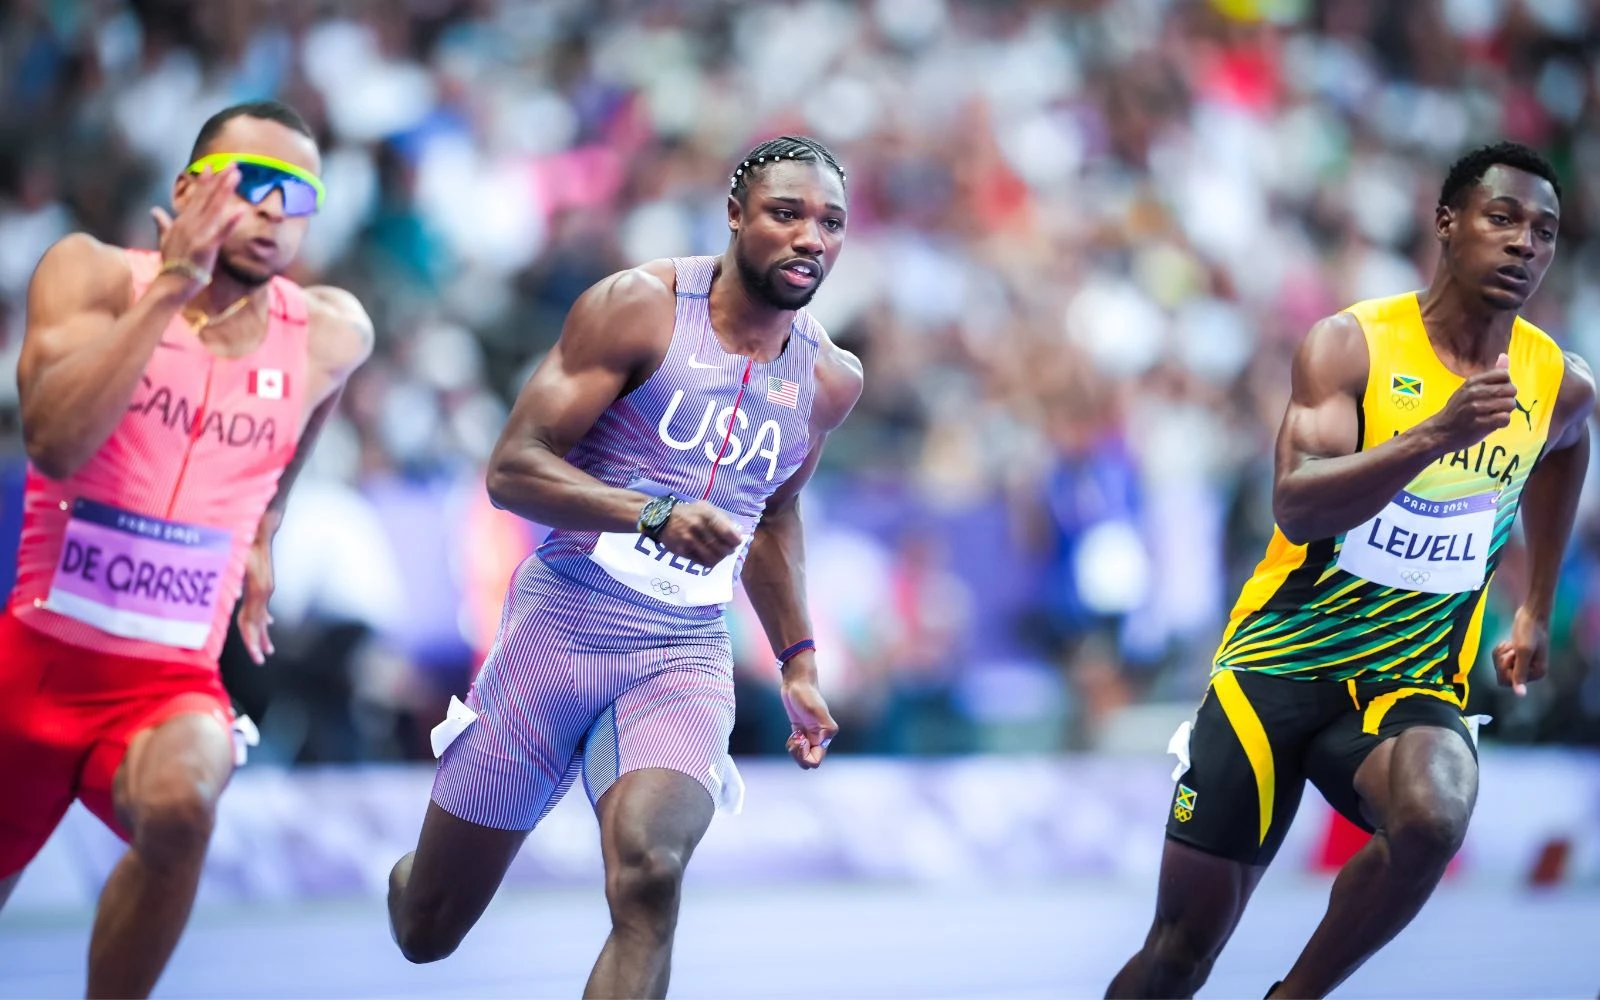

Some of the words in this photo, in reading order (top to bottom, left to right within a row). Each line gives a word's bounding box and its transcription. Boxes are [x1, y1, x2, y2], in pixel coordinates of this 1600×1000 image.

[658, 389, 781, 482] USA
[1403, 495, 1440, 514] PARIS
[1442, 501, 1469, 514] 2024
[1367, 517, 1476, 562] LEVELL
[61, 540, 103, 583] DE
[105, 554, 217, 607] GRASSE
